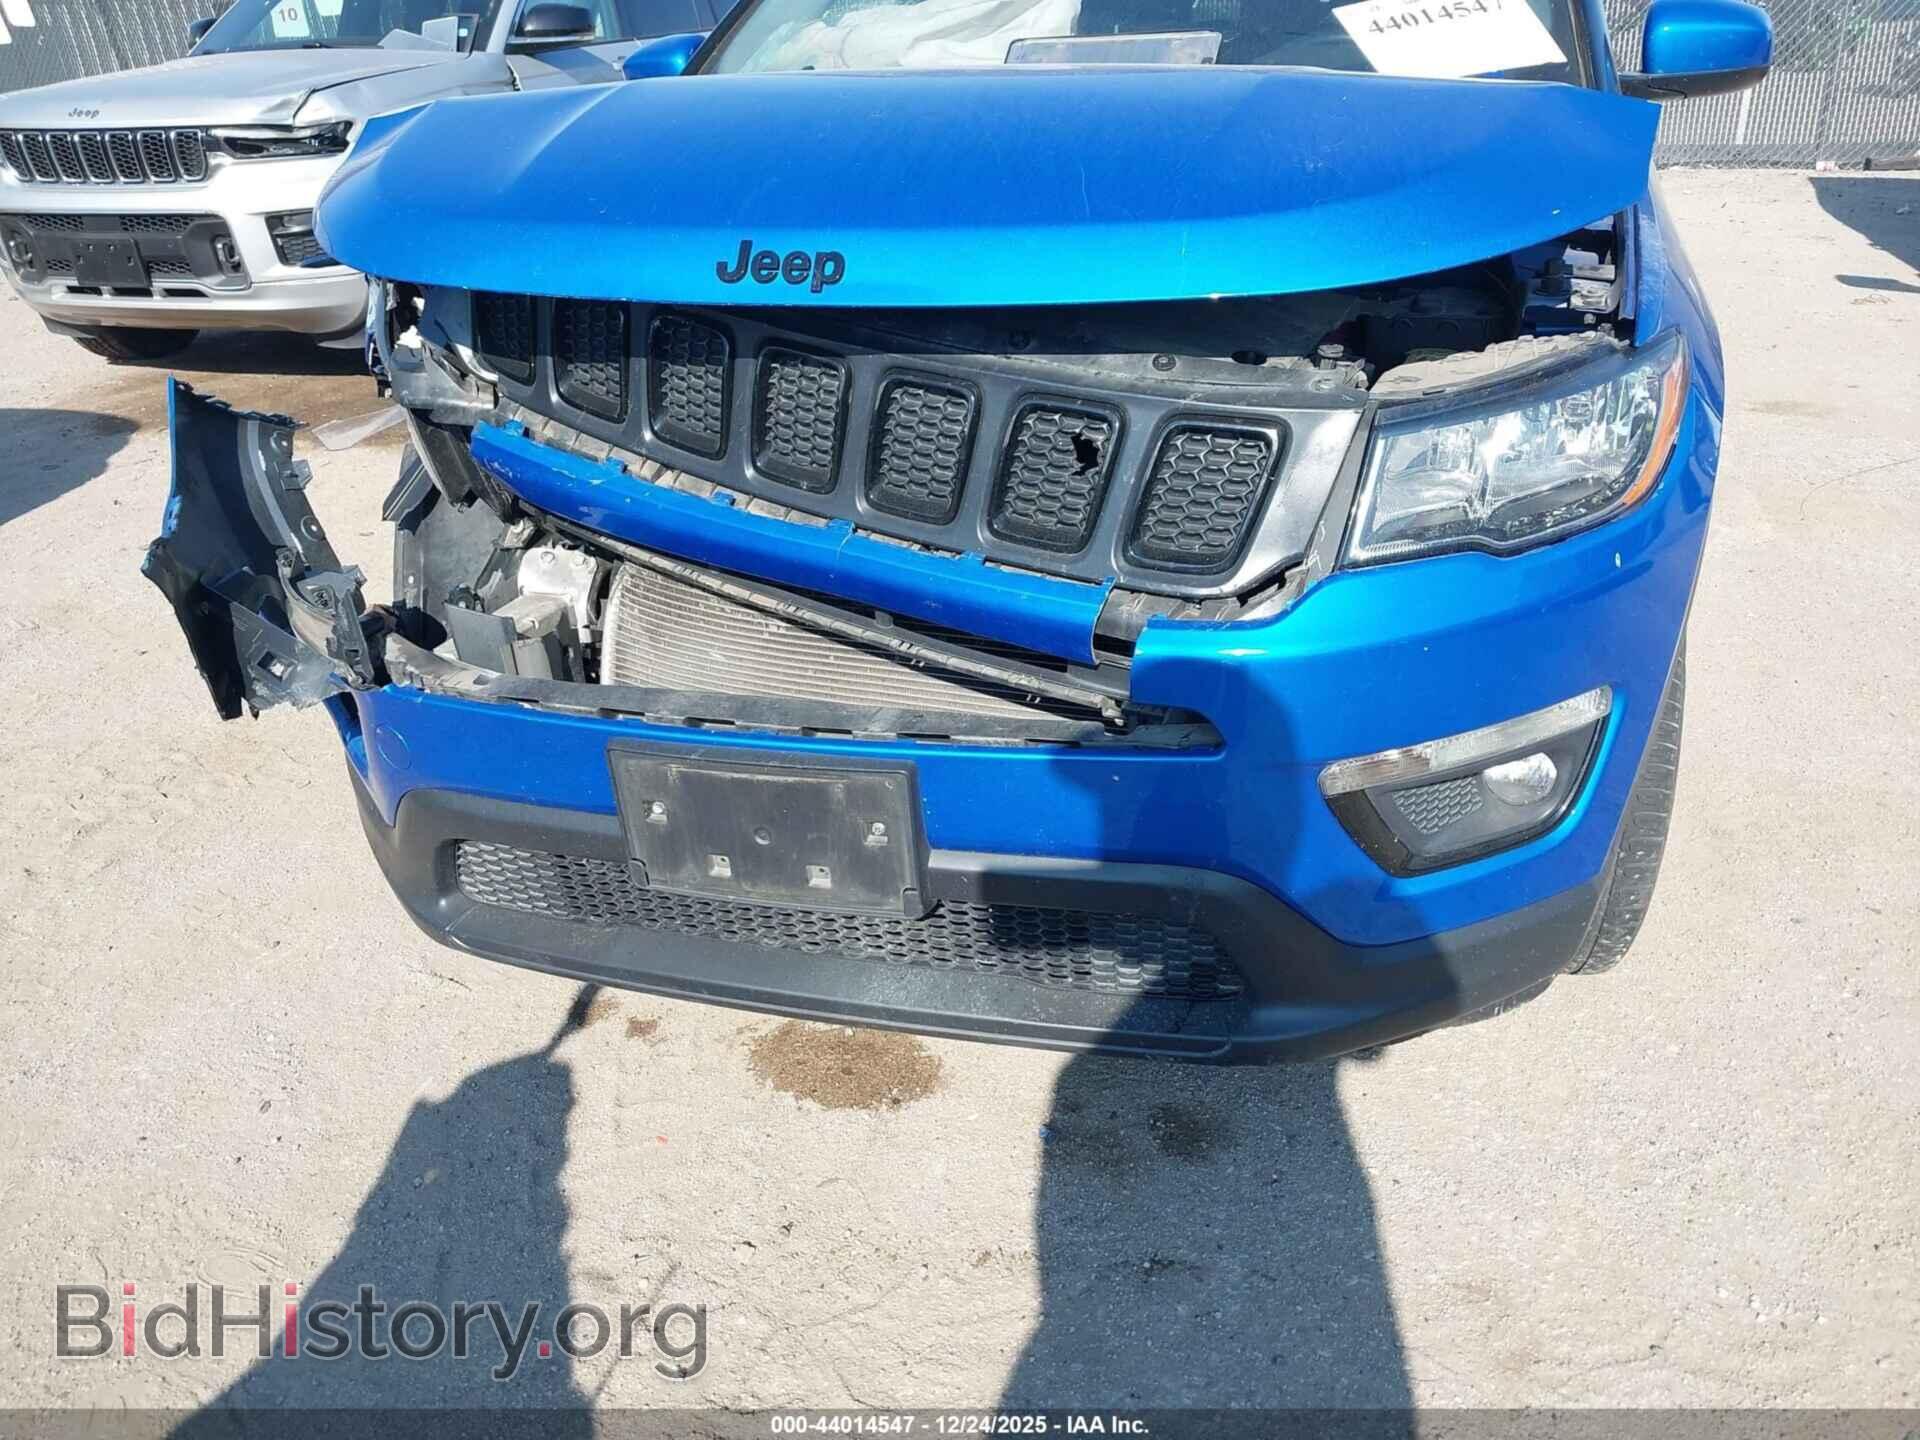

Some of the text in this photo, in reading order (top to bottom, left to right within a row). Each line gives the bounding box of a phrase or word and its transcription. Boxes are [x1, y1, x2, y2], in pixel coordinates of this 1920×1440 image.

[279, 7, 298, 22] 10
[68, 107, 100, 119] Jeep
[716, 239, 846, 293] Jeep
